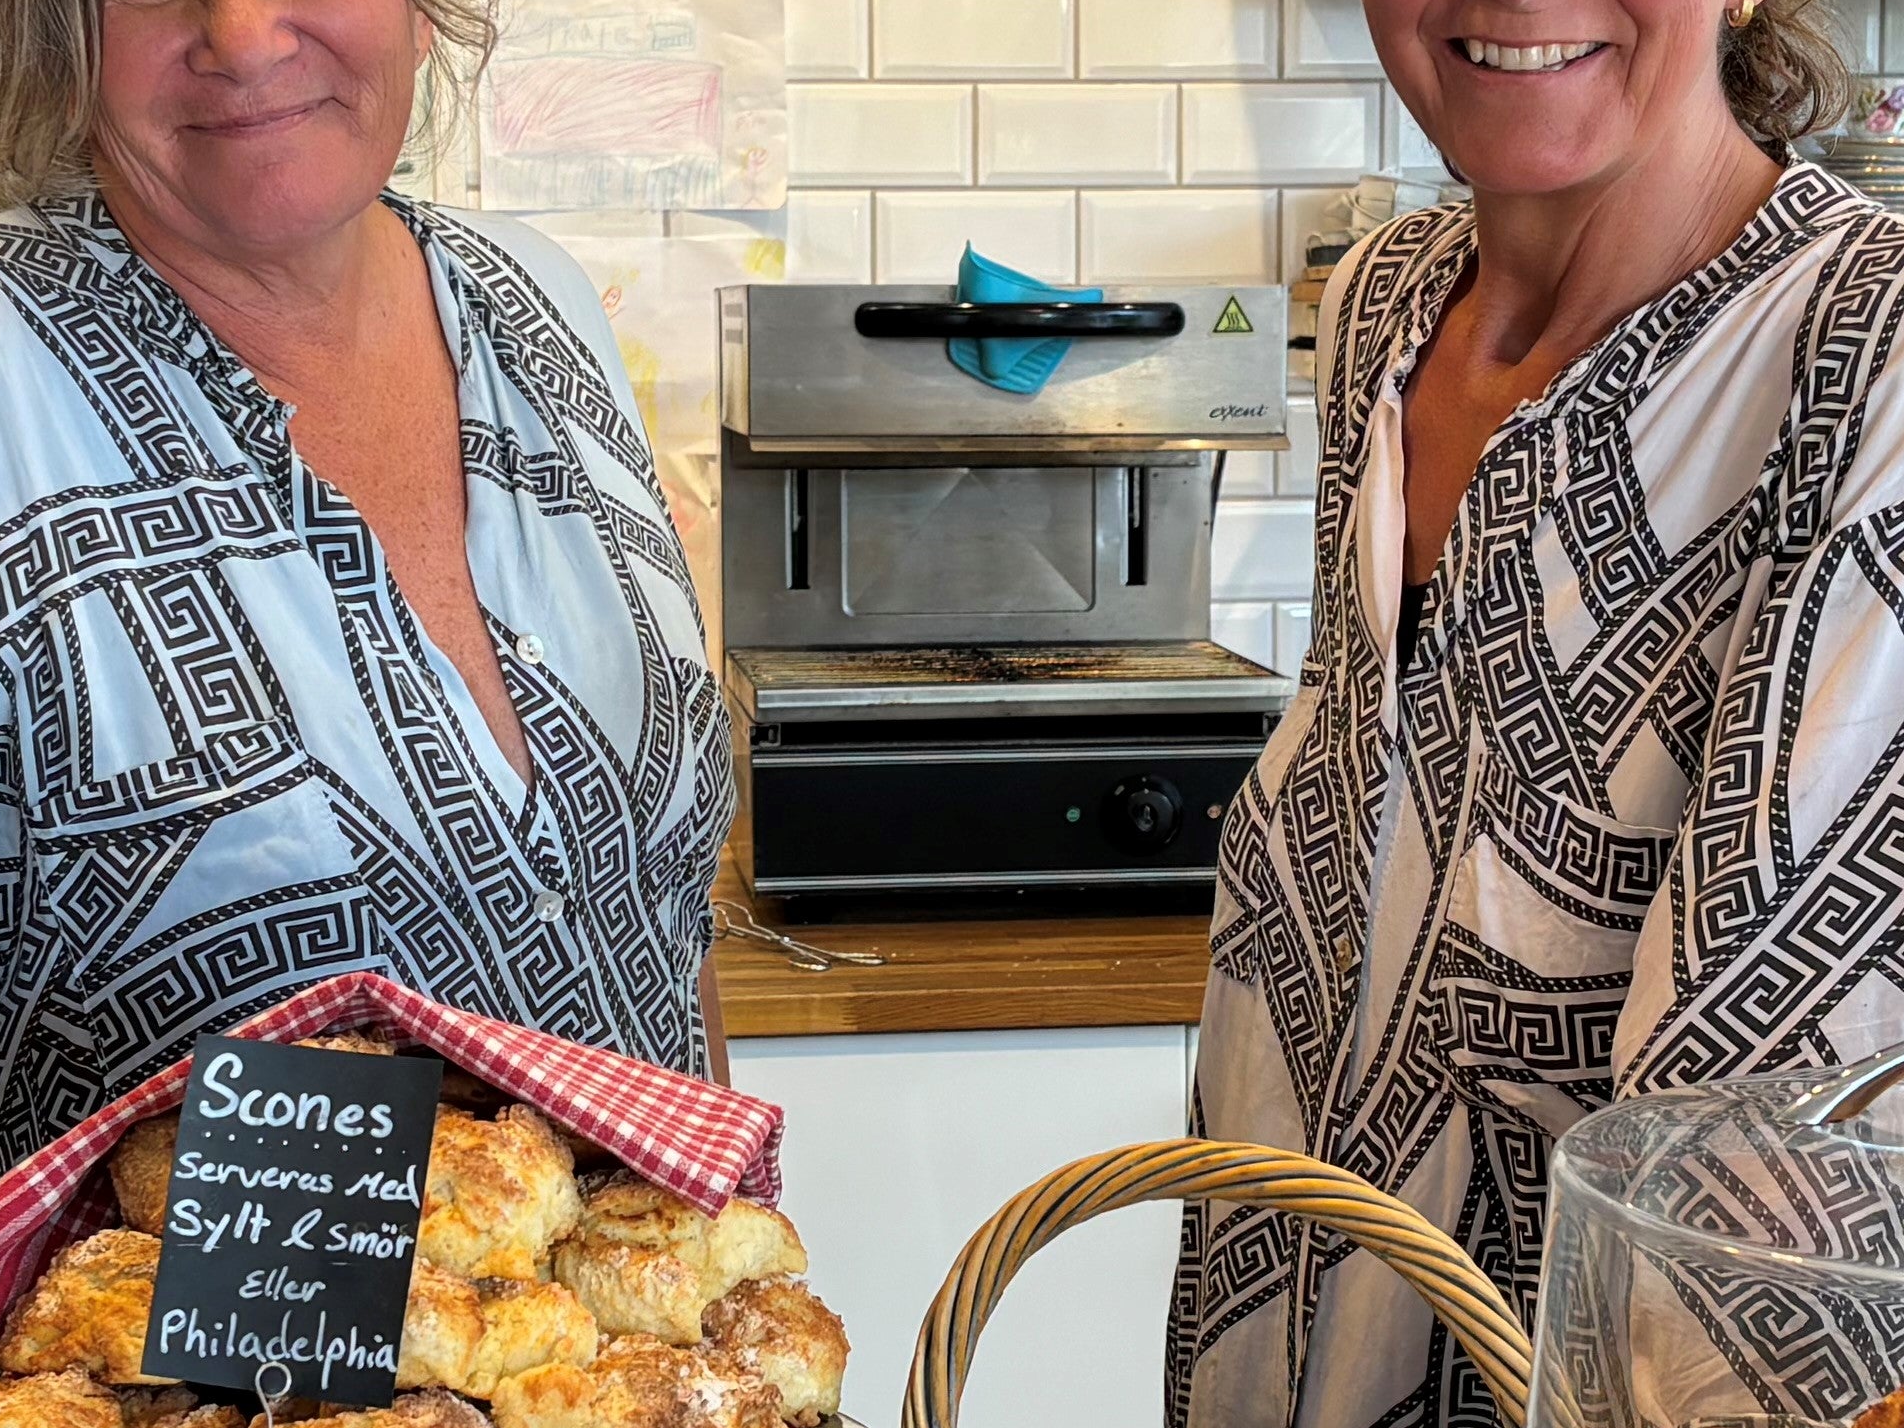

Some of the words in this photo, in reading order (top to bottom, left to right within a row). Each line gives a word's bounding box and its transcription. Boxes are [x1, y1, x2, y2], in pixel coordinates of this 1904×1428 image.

[199, 1053, 393, 1138] Scones
[174, 1152, 333, 1195] Serveras
[169, 1199, 271, 1253] Sylt
[239, 1266, 326, 1301] Eller
[159, 1309, 398, 1389] Philadelphia
